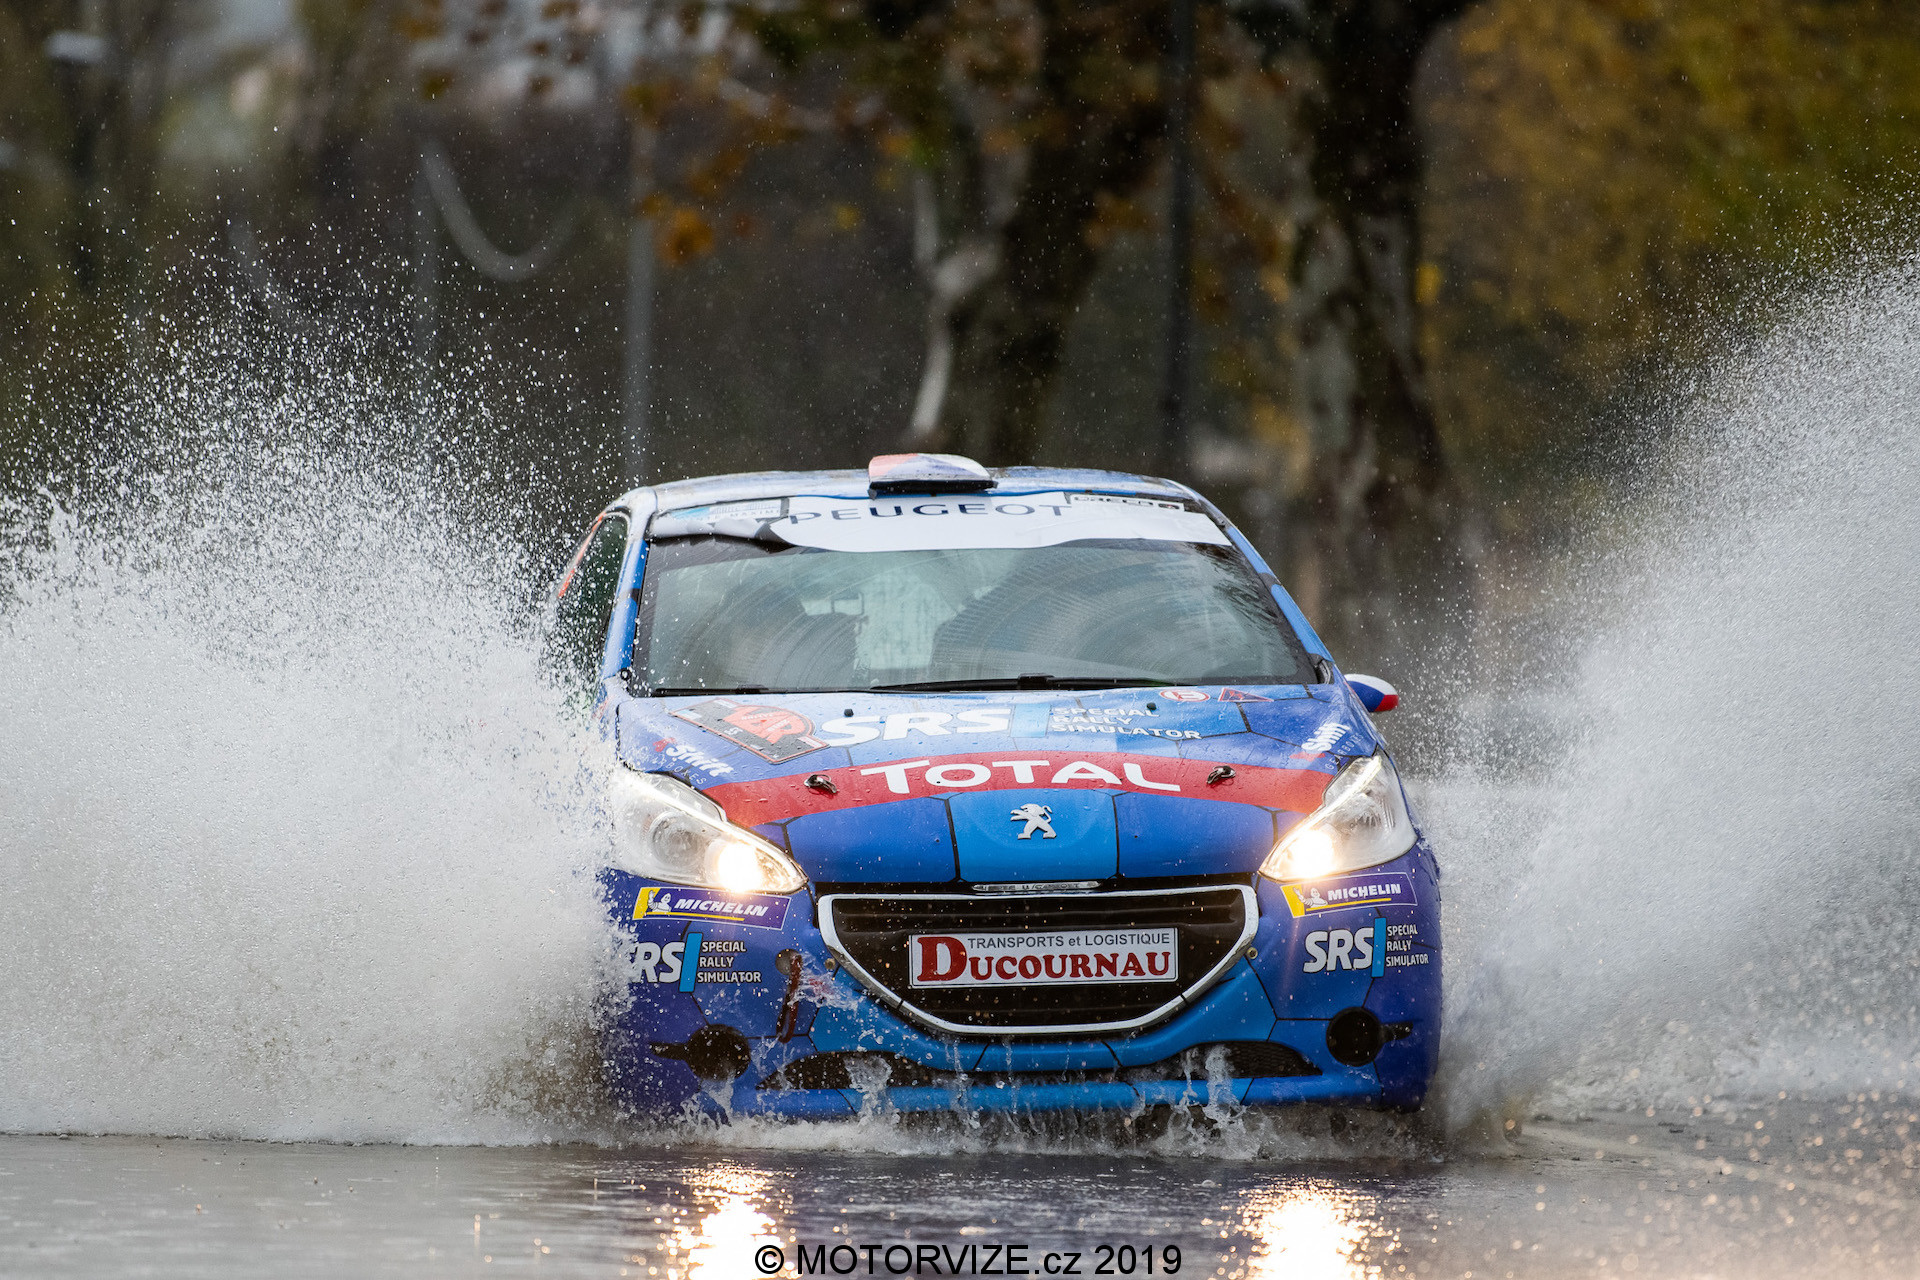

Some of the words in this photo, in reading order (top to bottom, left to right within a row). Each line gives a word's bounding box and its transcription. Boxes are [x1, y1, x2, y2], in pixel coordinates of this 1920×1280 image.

[789, 504, 1072, 524] PEUGEOT
[1053, 707, 1160, 717] SPECIAL
[1053, 715, 1133, 725] RALLY
[821, 708, 1012, 747] SRS
[1051, 724, 1202, 740] SIMULATOR
[861, 760, 1181, 794] TOTAL
[1327, 883, 1401, 901] MICHELIN
[674, 897, 769, 917] MICHELIN
[1387, 924, 1418, 936] SPECIAL
[702, 941, 747, 952] SPECIAL
[968, 936, 1064, 949] TRANSPORTS
[1069, 937, 1081, 947] et
[1085, 933, 1170, 946] LOGISTIQUE
[1386, 940, 1412, 952] RALLY
[1303, 927, 1374, 973] SRS
[628, 942, 685, 983] RS
[699, 957, 734, 968] RALLY
[917, 936, 1171, 982] DUCOURNAU
[1386, 954, 1429, 967] SIMULATOR
[697, 971, 761, 983] SIMULATOR
